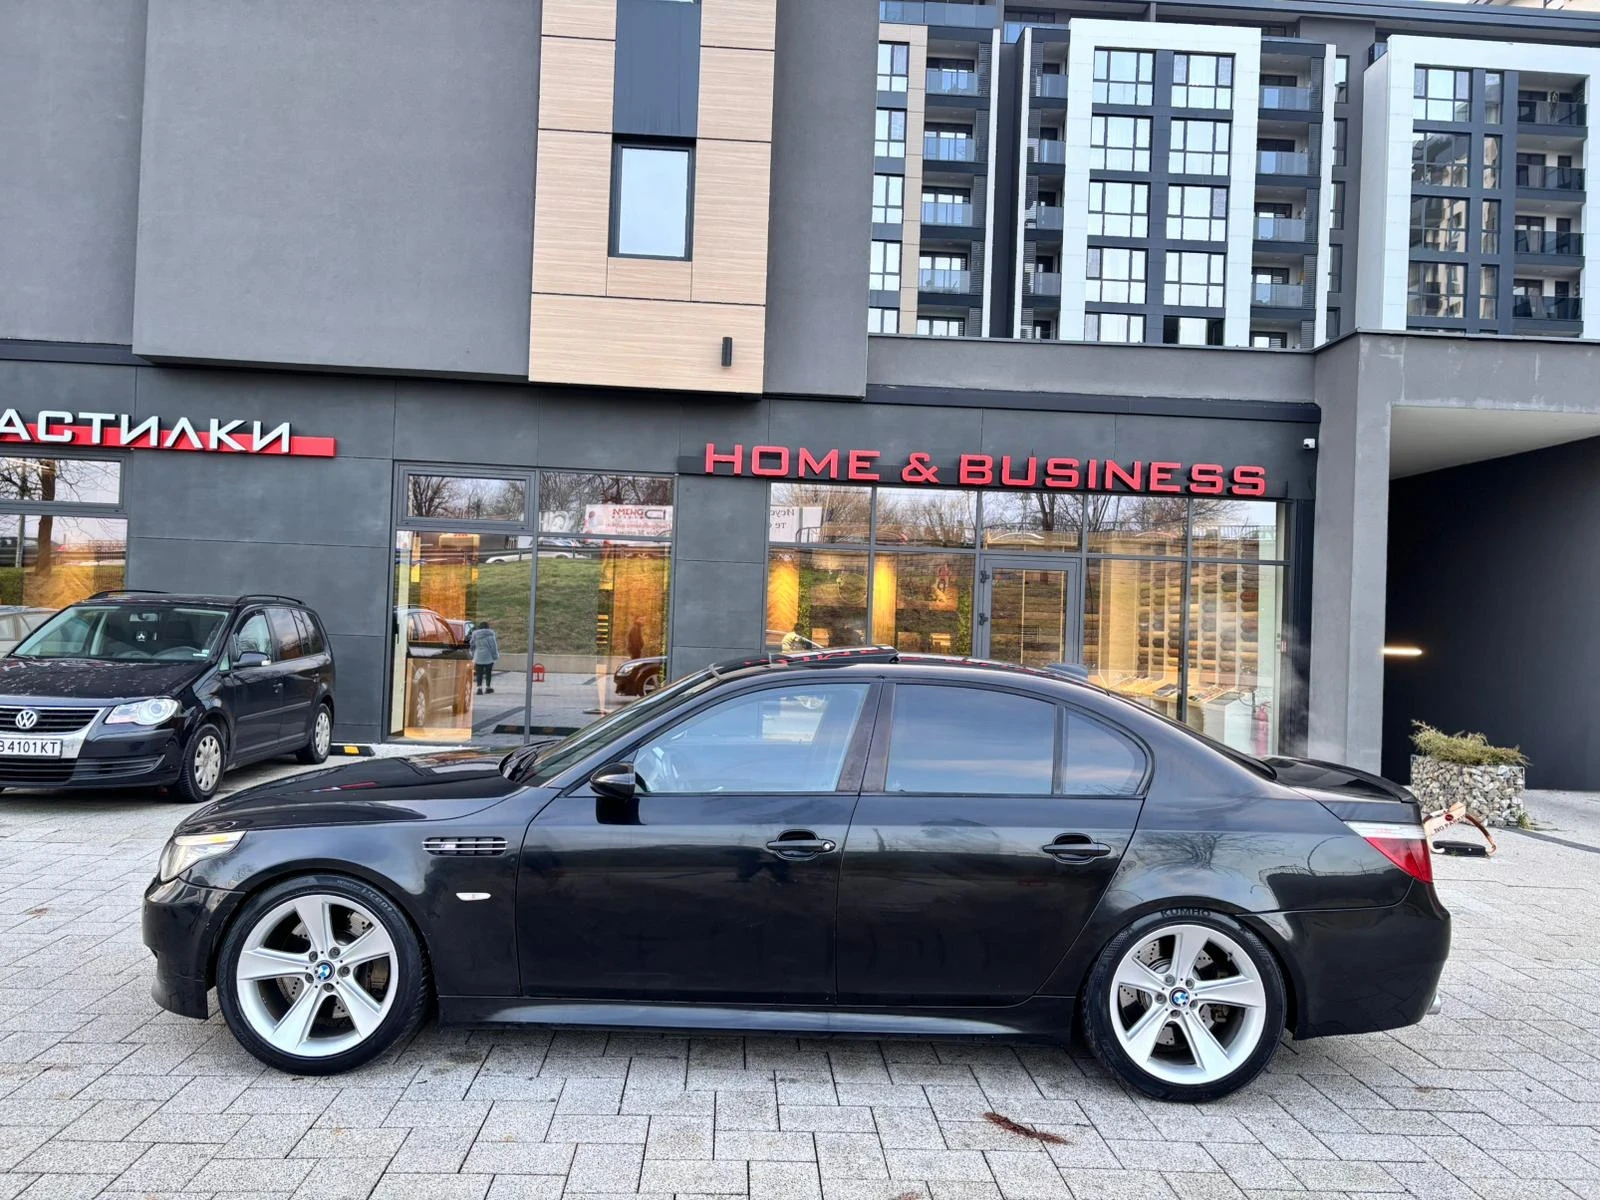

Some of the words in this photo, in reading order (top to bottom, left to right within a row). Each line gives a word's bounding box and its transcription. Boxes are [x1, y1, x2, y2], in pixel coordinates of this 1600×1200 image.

[0, 408, 291, 453] АСТИЛКИ
[705, 443, 881, 481] HOME
[902, 452, 940, 484] &
[959, 453, 1266, 497] BUSINESS
[15, 709, 38, 730] VW
[1160, 908, 1211, 919] KUMHO
